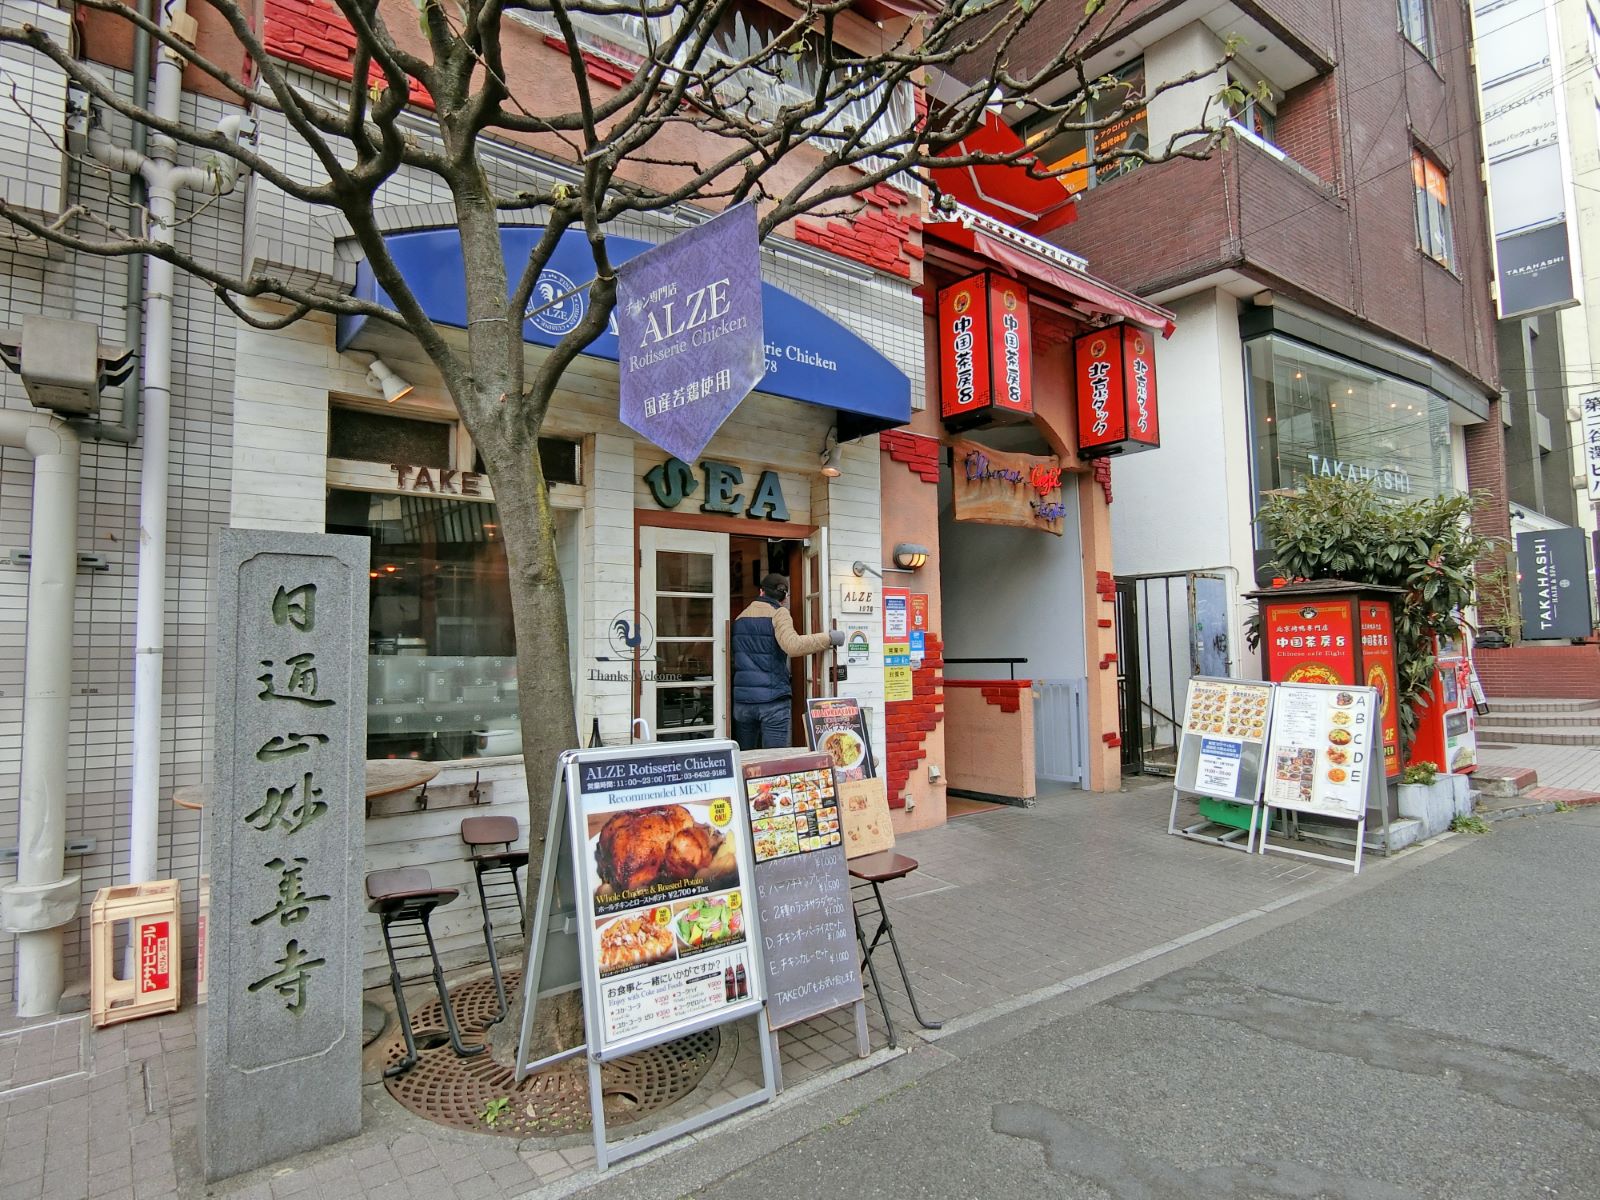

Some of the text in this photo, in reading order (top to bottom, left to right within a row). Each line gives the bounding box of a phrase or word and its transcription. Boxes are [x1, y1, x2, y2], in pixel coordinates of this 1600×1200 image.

[1506, 256, 1564, 276] TAKAHASHI
[640, 278, 731, 348] ALZE
[629, 315, 747, 373] Rotisserie Chicken
[785, 345, 837, 371] Chicken
[954, 315, 974, 405] 中国茶房8
[1003, 313, 1021, 402] 中国茶房8
[644, 368, 731, 418] 国産若鶏使用
[1089, 362, 1111, 436] 北京ダック
[1132, 358, 1149, 432] 北京ダック
[390, 464, 483, 497] TAKE
[1308, 454, 1411, 494] TAKAHASHI
[644, 456, 790, 522] SEA
[1549, 565, 1557, 578] SPA
[1534, 538, 1553, 630] TAKAHASHI
[1551, 585, 1559, 603] HAIR
[843, 591, 873, 602] ALZE
[1276, 635, 1345, 648] 中国茶房8
[587, 669, 629, 681] Thanks
[1356, 696, 1365, 706] A
[1355, 713, 1365, 724] B
[1353, 734, 1362, 745] C
[1385, 728, 1394, 740] 2F
[586, 757, 726, 780] ALZE Rotisserie Chicken
[1353, 752, 1363, 763] D
[1351, 770, 1361, 782] E
[608, 781, 712, 804] Recommended MENU
[596, 893, 621, 903] Whole
[650, 884, 657, 893] &
[657, 880, 681, 892] Roasted
[683, 878, 704, 888] Potato
[143, 926, 157, 991] アサヒビール
